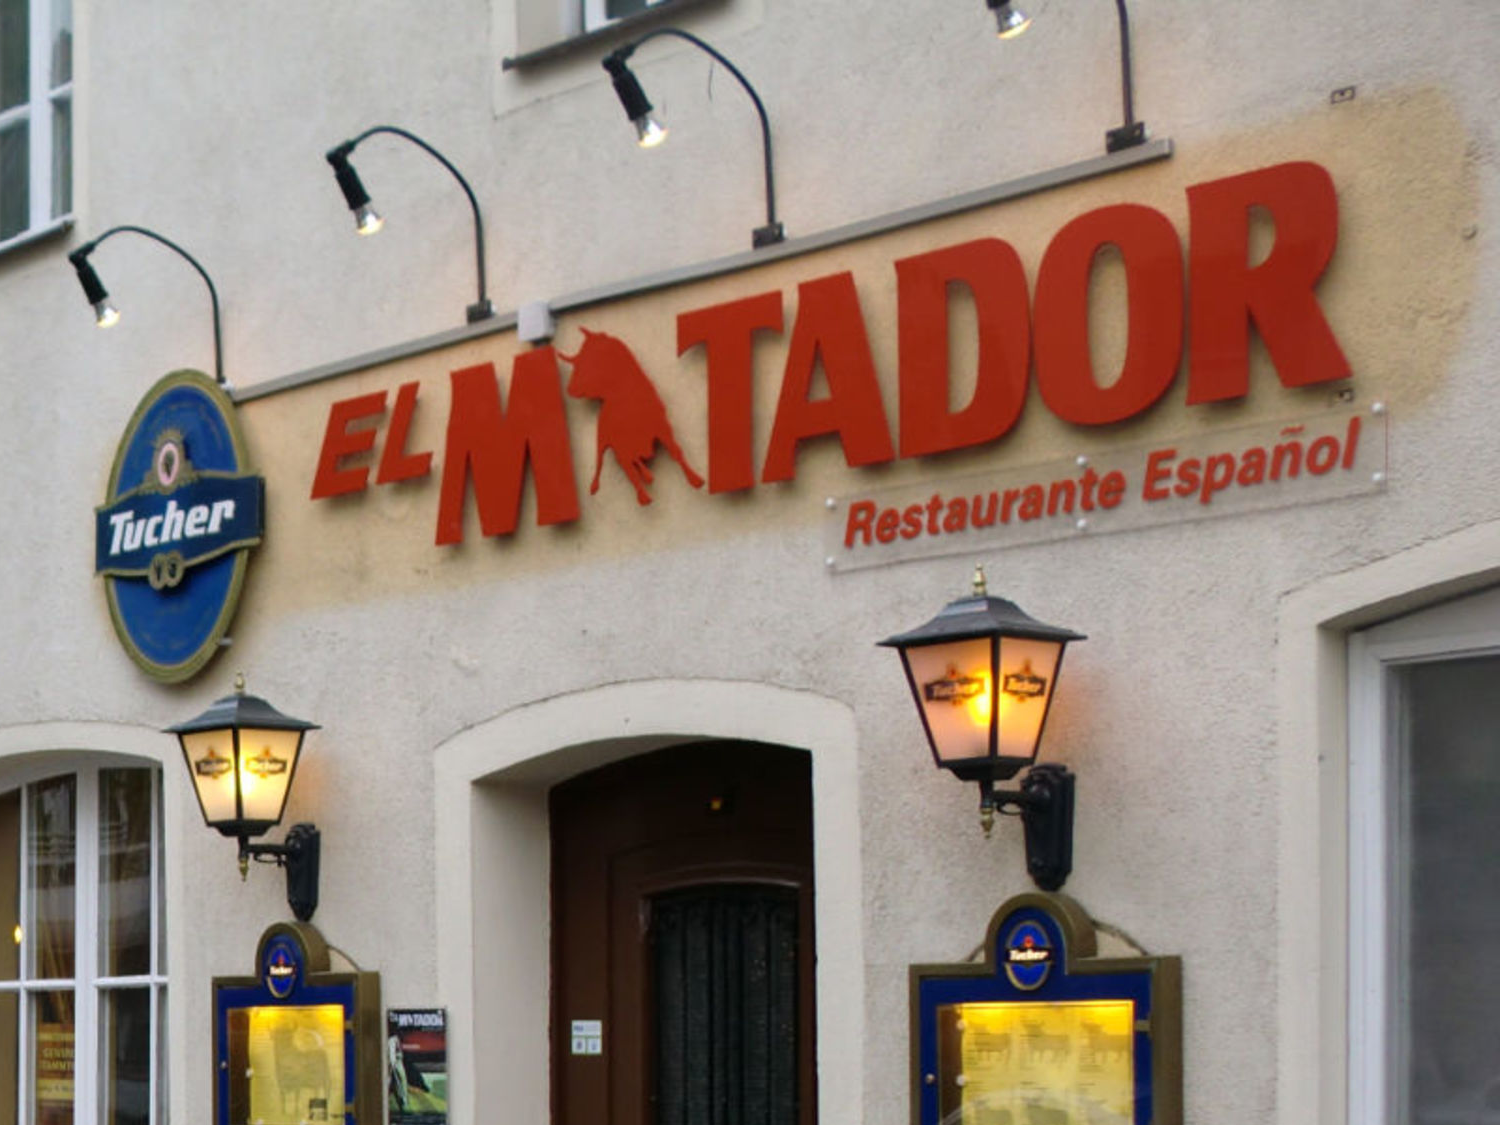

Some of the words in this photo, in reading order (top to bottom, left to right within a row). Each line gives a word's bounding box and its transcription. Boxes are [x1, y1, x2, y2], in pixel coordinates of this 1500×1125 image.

[310, 381, 434, 500] EL
[843, 467, 1127, 548] Restaurante
[1142, 416, 1361, 505] Español
[109, 499, 235, 555] Tucher
